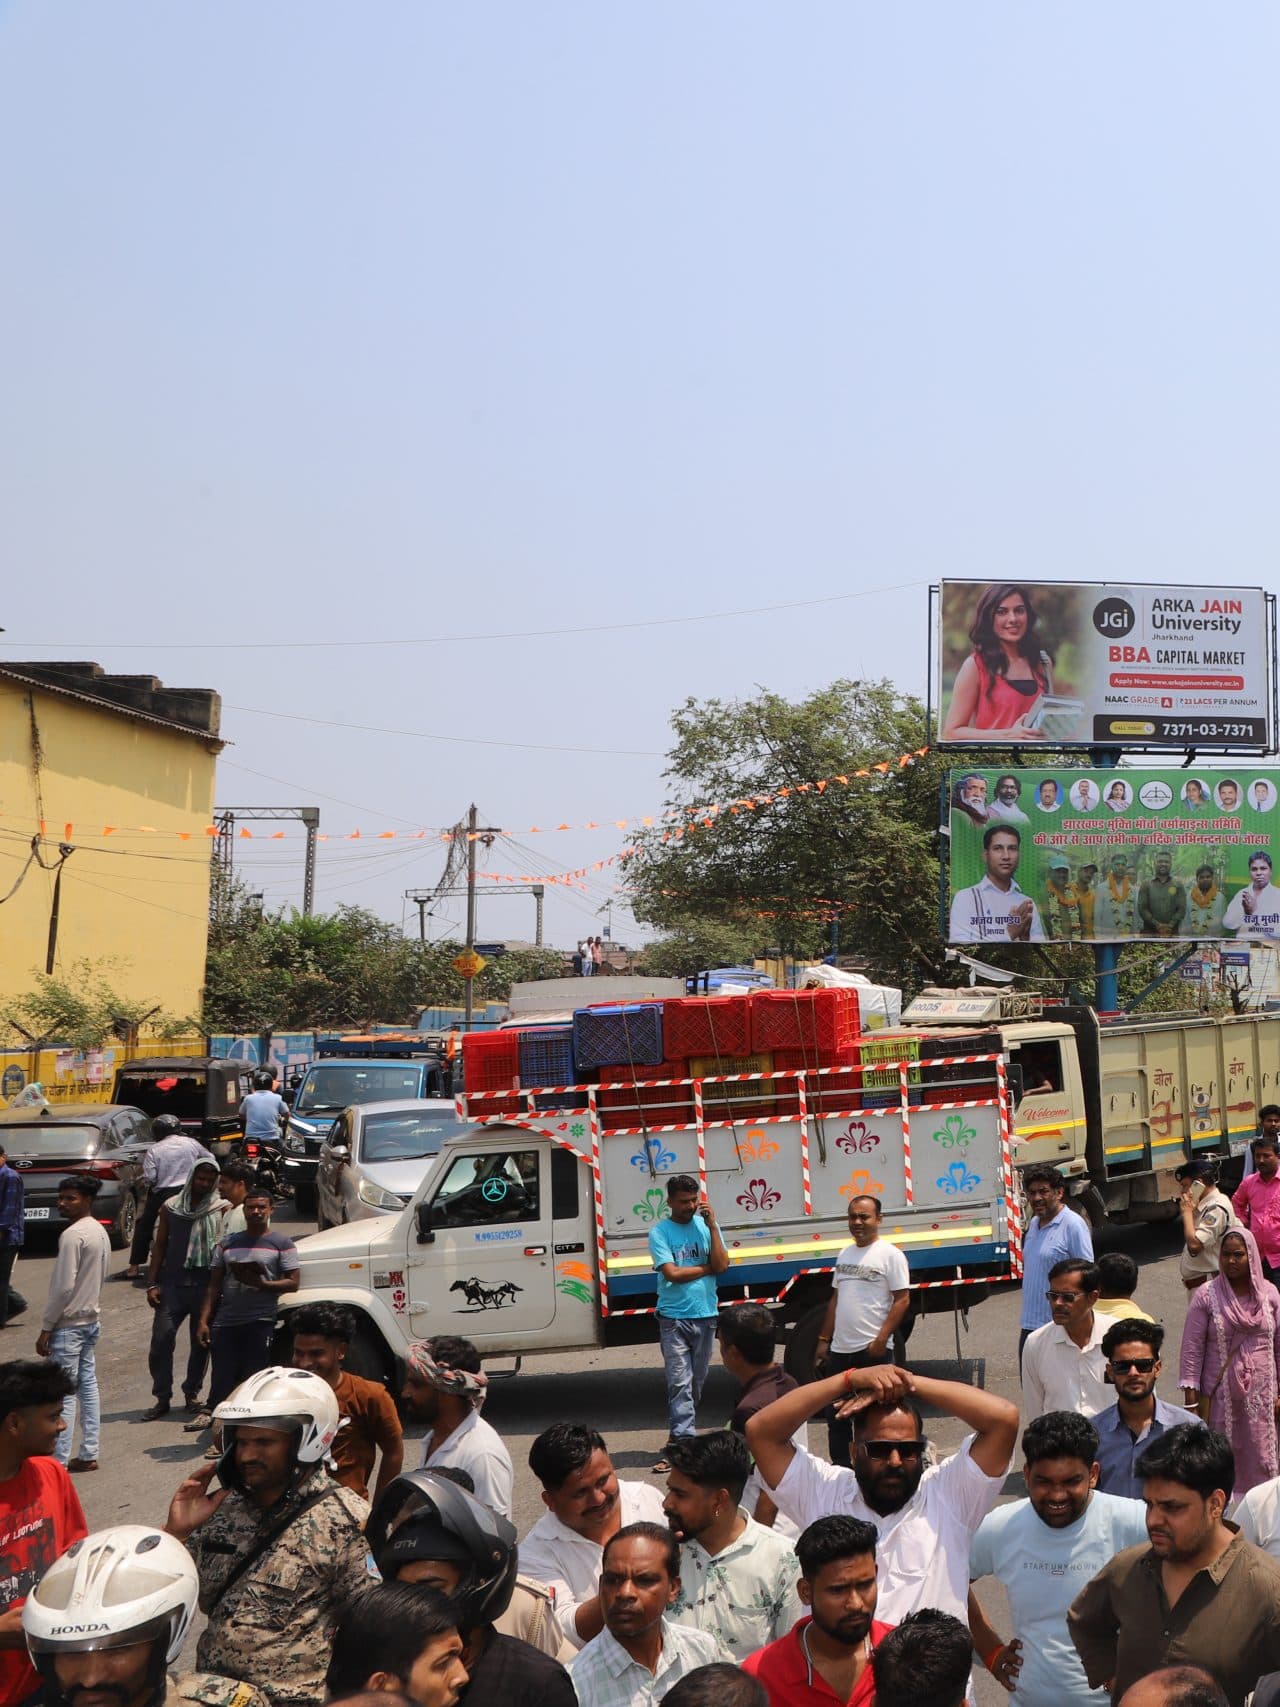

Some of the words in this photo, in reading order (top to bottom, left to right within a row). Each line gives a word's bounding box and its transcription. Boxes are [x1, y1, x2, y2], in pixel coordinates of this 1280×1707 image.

[1152, 599, 1195, 613] ARKA
[1200, 600, 1242, 614] JAIN
[1152, 614, 1241, 635] University
[1152, 634, 1194, 642] Jharkhand
[1109, 646, 1151, 663] BBA
[1156, 650, 1200, 664] CAPITAL
[1203, 652, 1245, 665] MARKET
[1114, 678, 1133, 686] Apply
[1131, 696, 1159, 704] GRADE
[1162, 724, 1254, 737] 7371-03-7371
[1034, 833, 1046, 845] की
[1050, 834, 1068, 845] ओर
[1083, 835, 1103, 846] आप
[1127, 835, 1140, 845] का
[1023, 1107, 1069, 1120] Welcome
[50, 1623, 111, 1636] HONDA
